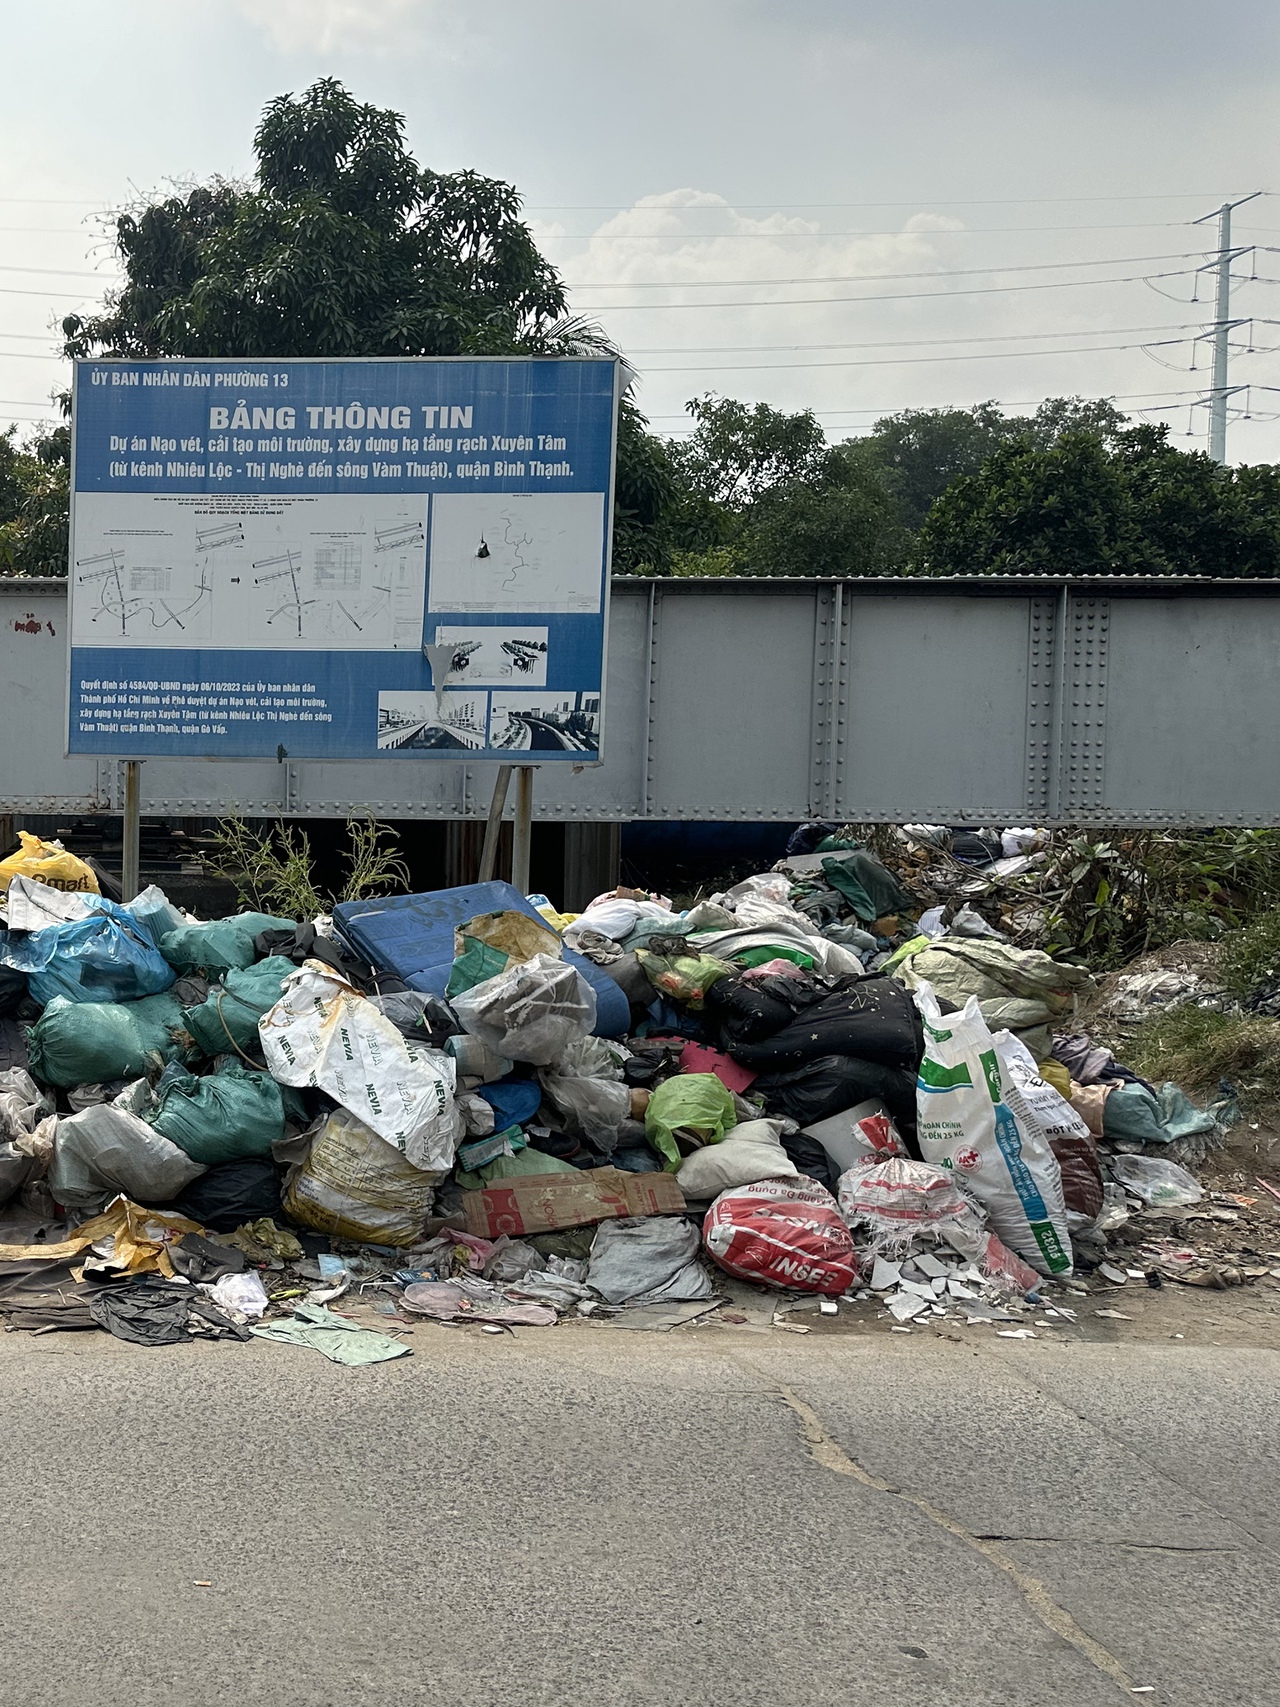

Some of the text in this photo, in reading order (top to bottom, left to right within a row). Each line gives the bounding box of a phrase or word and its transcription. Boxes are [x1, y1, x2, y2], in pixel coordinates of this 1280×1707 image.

[91, 367, 288, 387] ỦY BAN NHÂN DÂN PHƯỜNG 13
[210, 400, 473, 430] BẢNG THÔNG TIN
[110, 433, 566, 454] Dự án Nạo vét, cải tạo môi trường, xây dựng hạ tầng rạch Xuyên Tâm
[110, 462, 128, 478] (từ
[131, 461, 162, 478] kênh
[167, 462, 204, 478] Nhiêu
[210, 461, 232, 480] Lộc
[246, 462, 265, 480] Thị
[270, 462, 303, 480] Nghè
[308, 460, 332, 478] đến
[336, 462, 368, 478] sông
[373, 462, 401, 477] Vàm
[406, 461, 452, 480] Thuật),
[457, 462, 489, 480] quận
[494, 461, 524, 476] Bình
[530, 461, 574, 480] Thạnh.
[81, 679, 100, 690] Quyết
[102, 680, 117, 691] định
[119, 680, 128, 690] số
[182, 682, 198, 691] ngày
[242, 682, 255, 692] của
[257, 680, 266, 693] Ủy
[268, 682, 280, 692] ban
[282, 682, 300, 692] nhân
[302, 683, 315, 692] dân
[80, 693, 327, 708] Thành phố Hồ Chí Minh về Phê duyệt dự án Nạo vét, cải tạo môi trường,
[278, 1035, 296, 1066] NEVIA
[341, 1028, 354, 1060] NEVIA
[366, 1032, 383, 1066] NEVIA
[366, 1083, 382, 1116] NEVIA
[396, 1081, 416, 1116] NEVIA
[434, 1080, 446, 1117] NEVIA
[1006, 1120, 1014, 1128] KG
[748, 1185, 777, 1194] Dụng
[780, 1190, 795, 1199] Đa
[1028, 1184, 1038, 1197] CHO
[769, 1256, 838, 1286] INSEE
